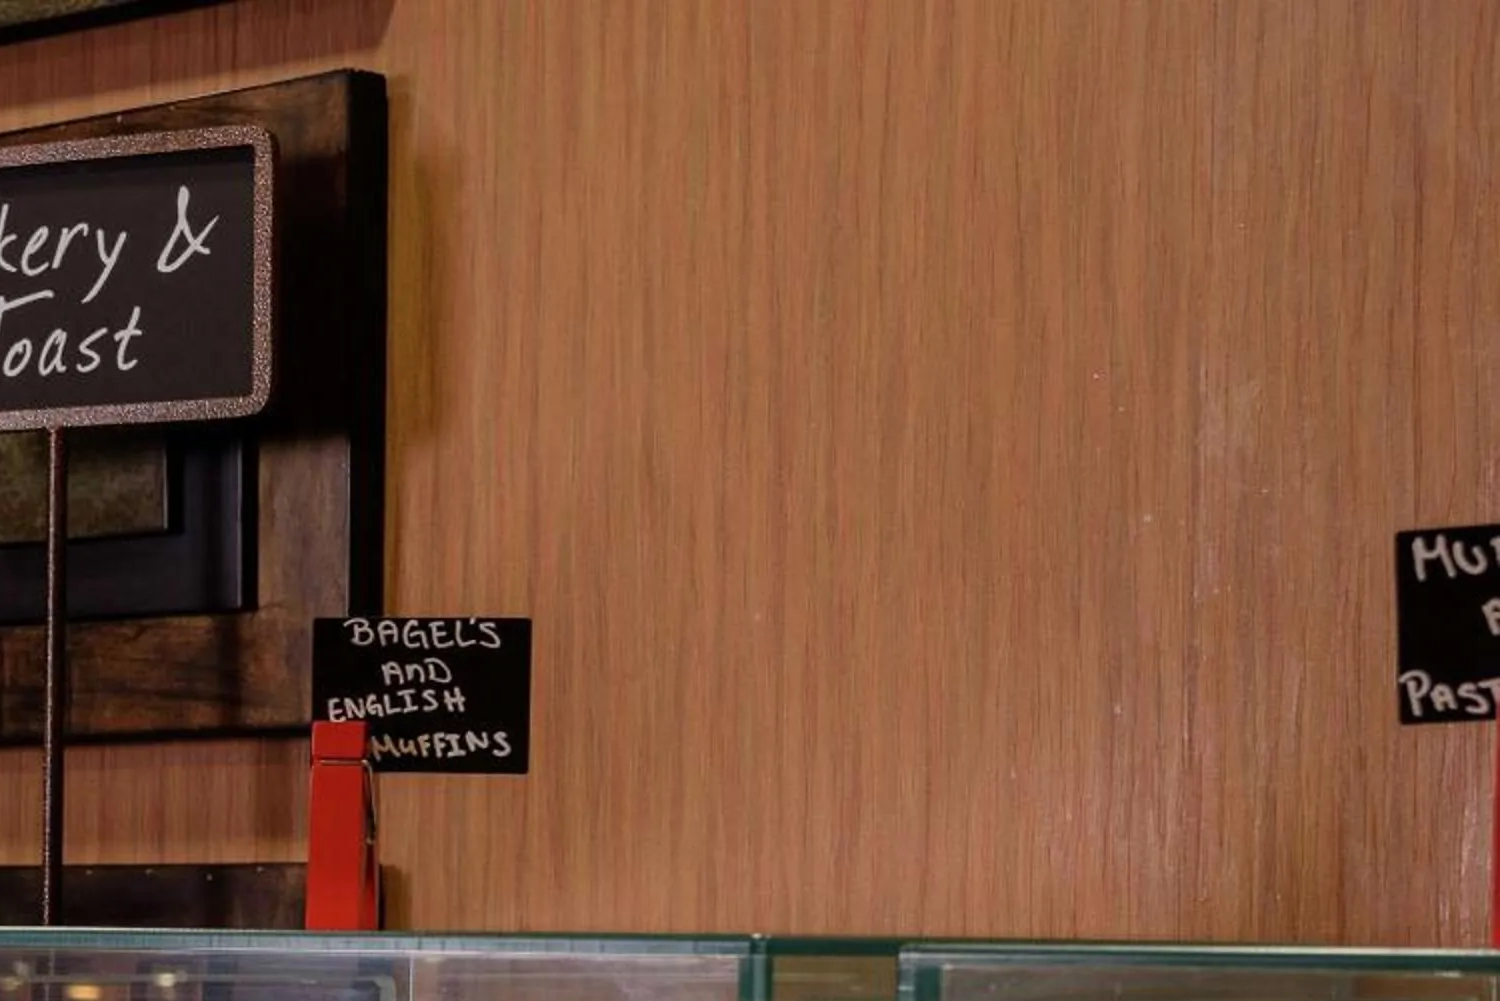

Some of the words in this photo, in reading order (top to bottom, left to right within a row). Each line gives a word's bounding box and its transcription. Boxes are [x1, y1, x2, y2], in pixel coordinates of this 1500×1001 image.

[156, 184, 221, 274] &
[342, 617, 502, 650] BAGEL'S
[327, 686, 467, 723] ENGLISH
